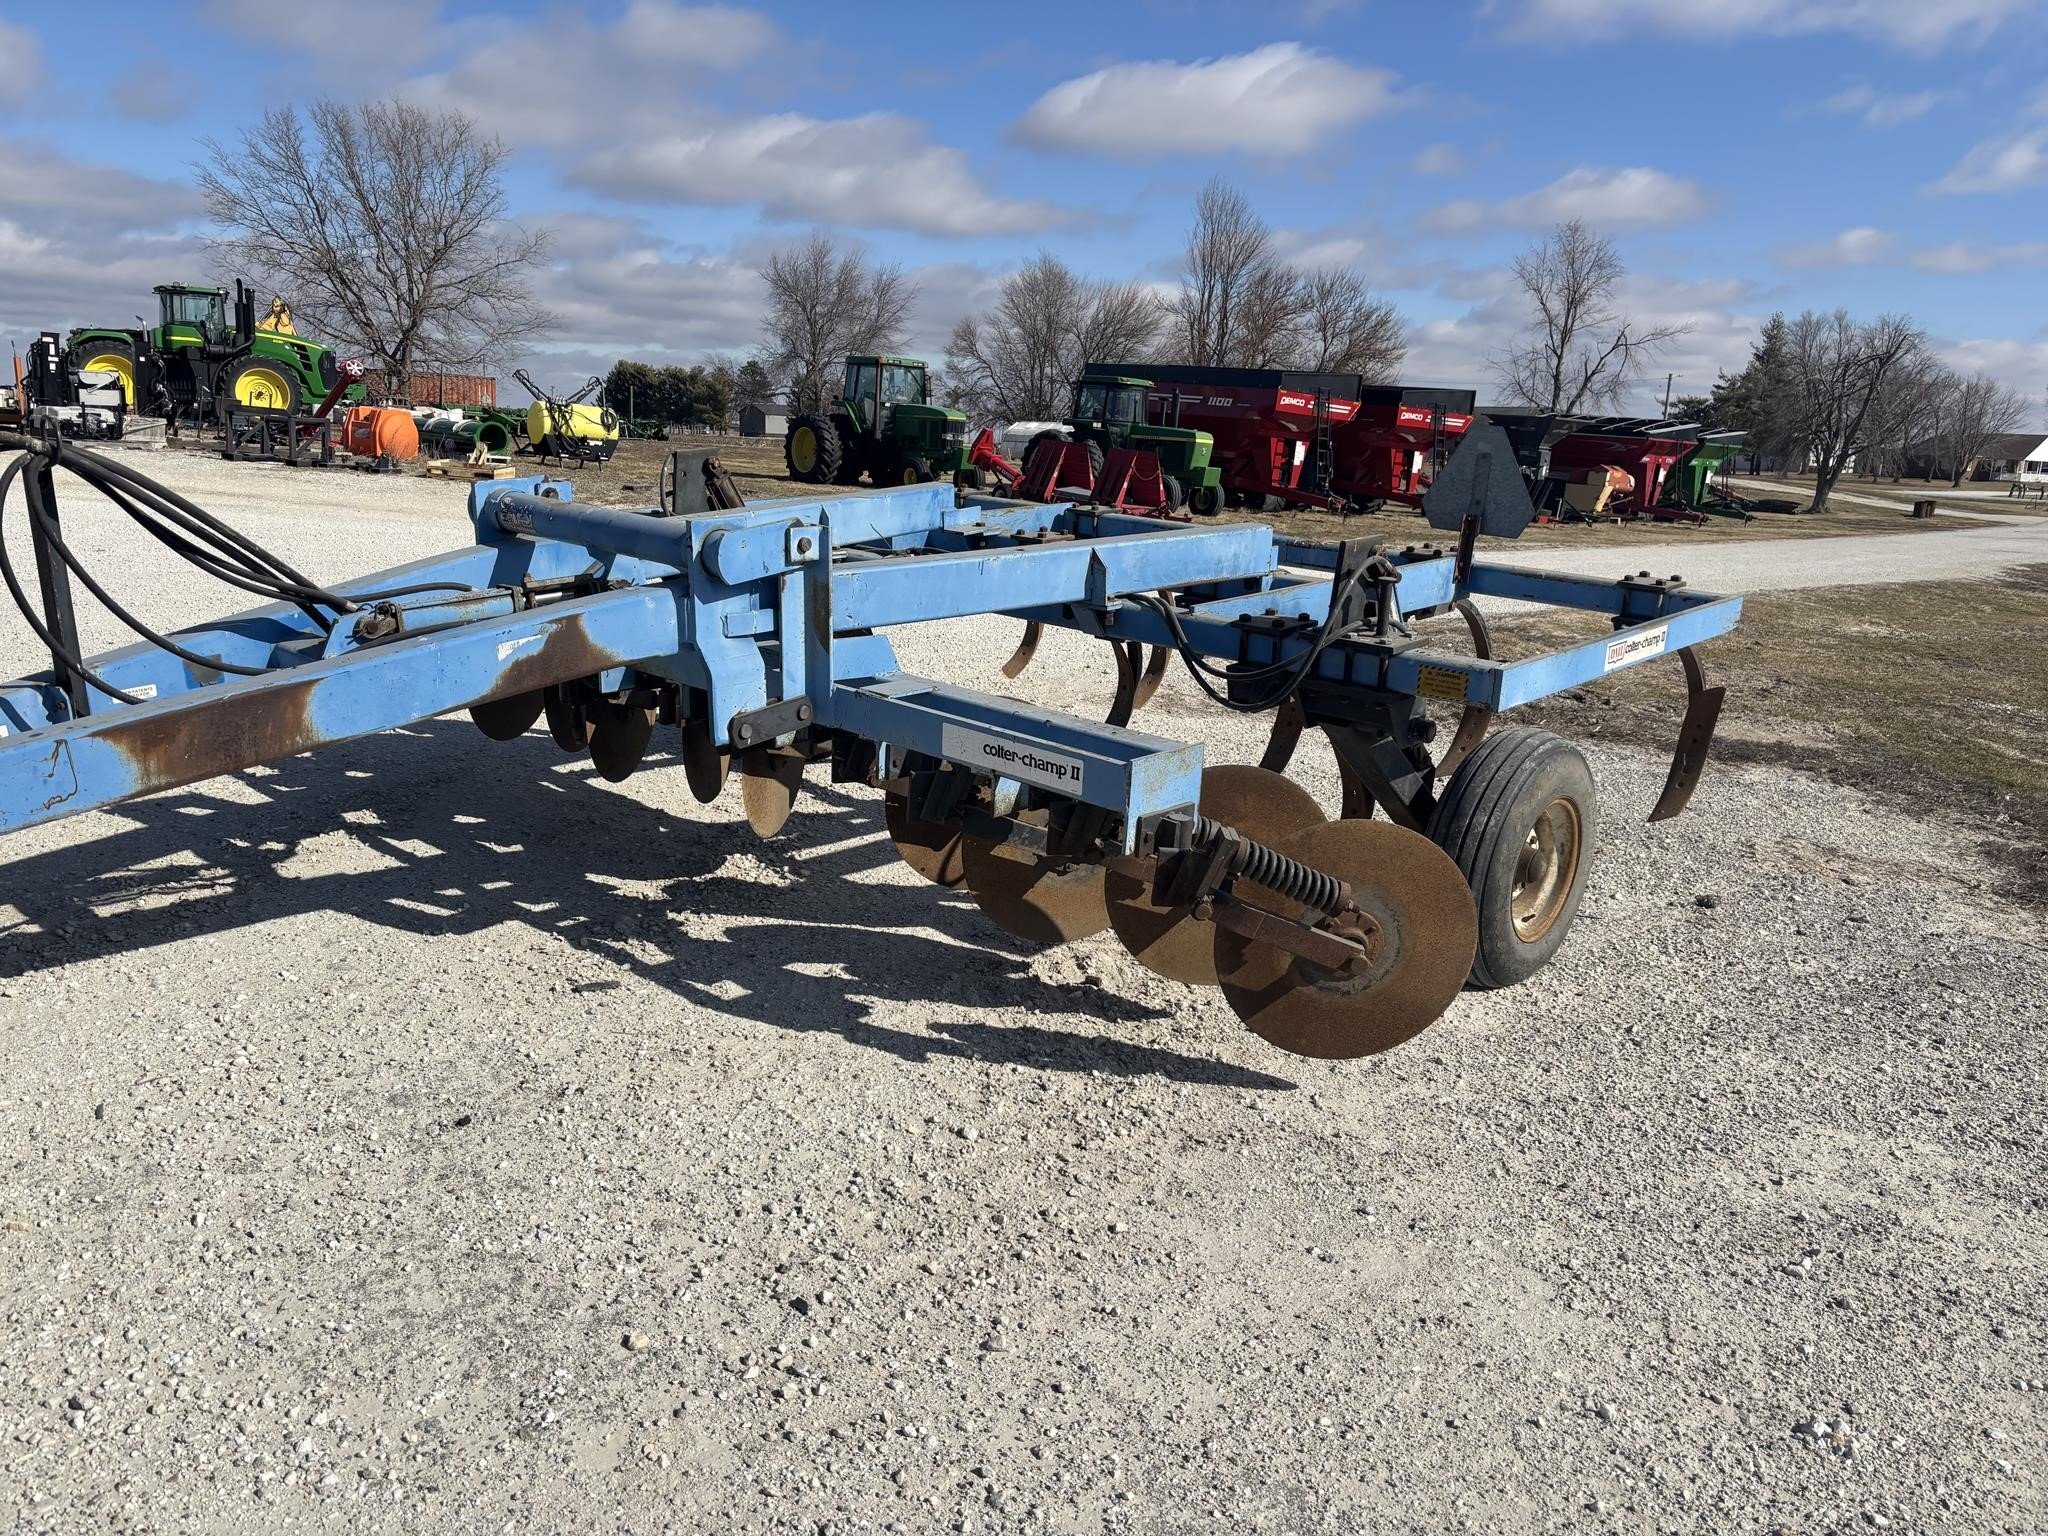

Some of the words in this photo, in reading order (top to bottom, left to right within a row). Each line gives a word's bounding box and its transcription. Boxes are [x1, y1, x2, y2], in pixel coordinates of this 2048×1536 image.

[1207, 397, 1233, 407] 1100
[1280, 396, 1305, 407] DEMCO
[1400, 412, 1423, 421] DEMCO
[983, 743, 1067, 780] colter-champ
[1070, 765, 1081, 781] II
